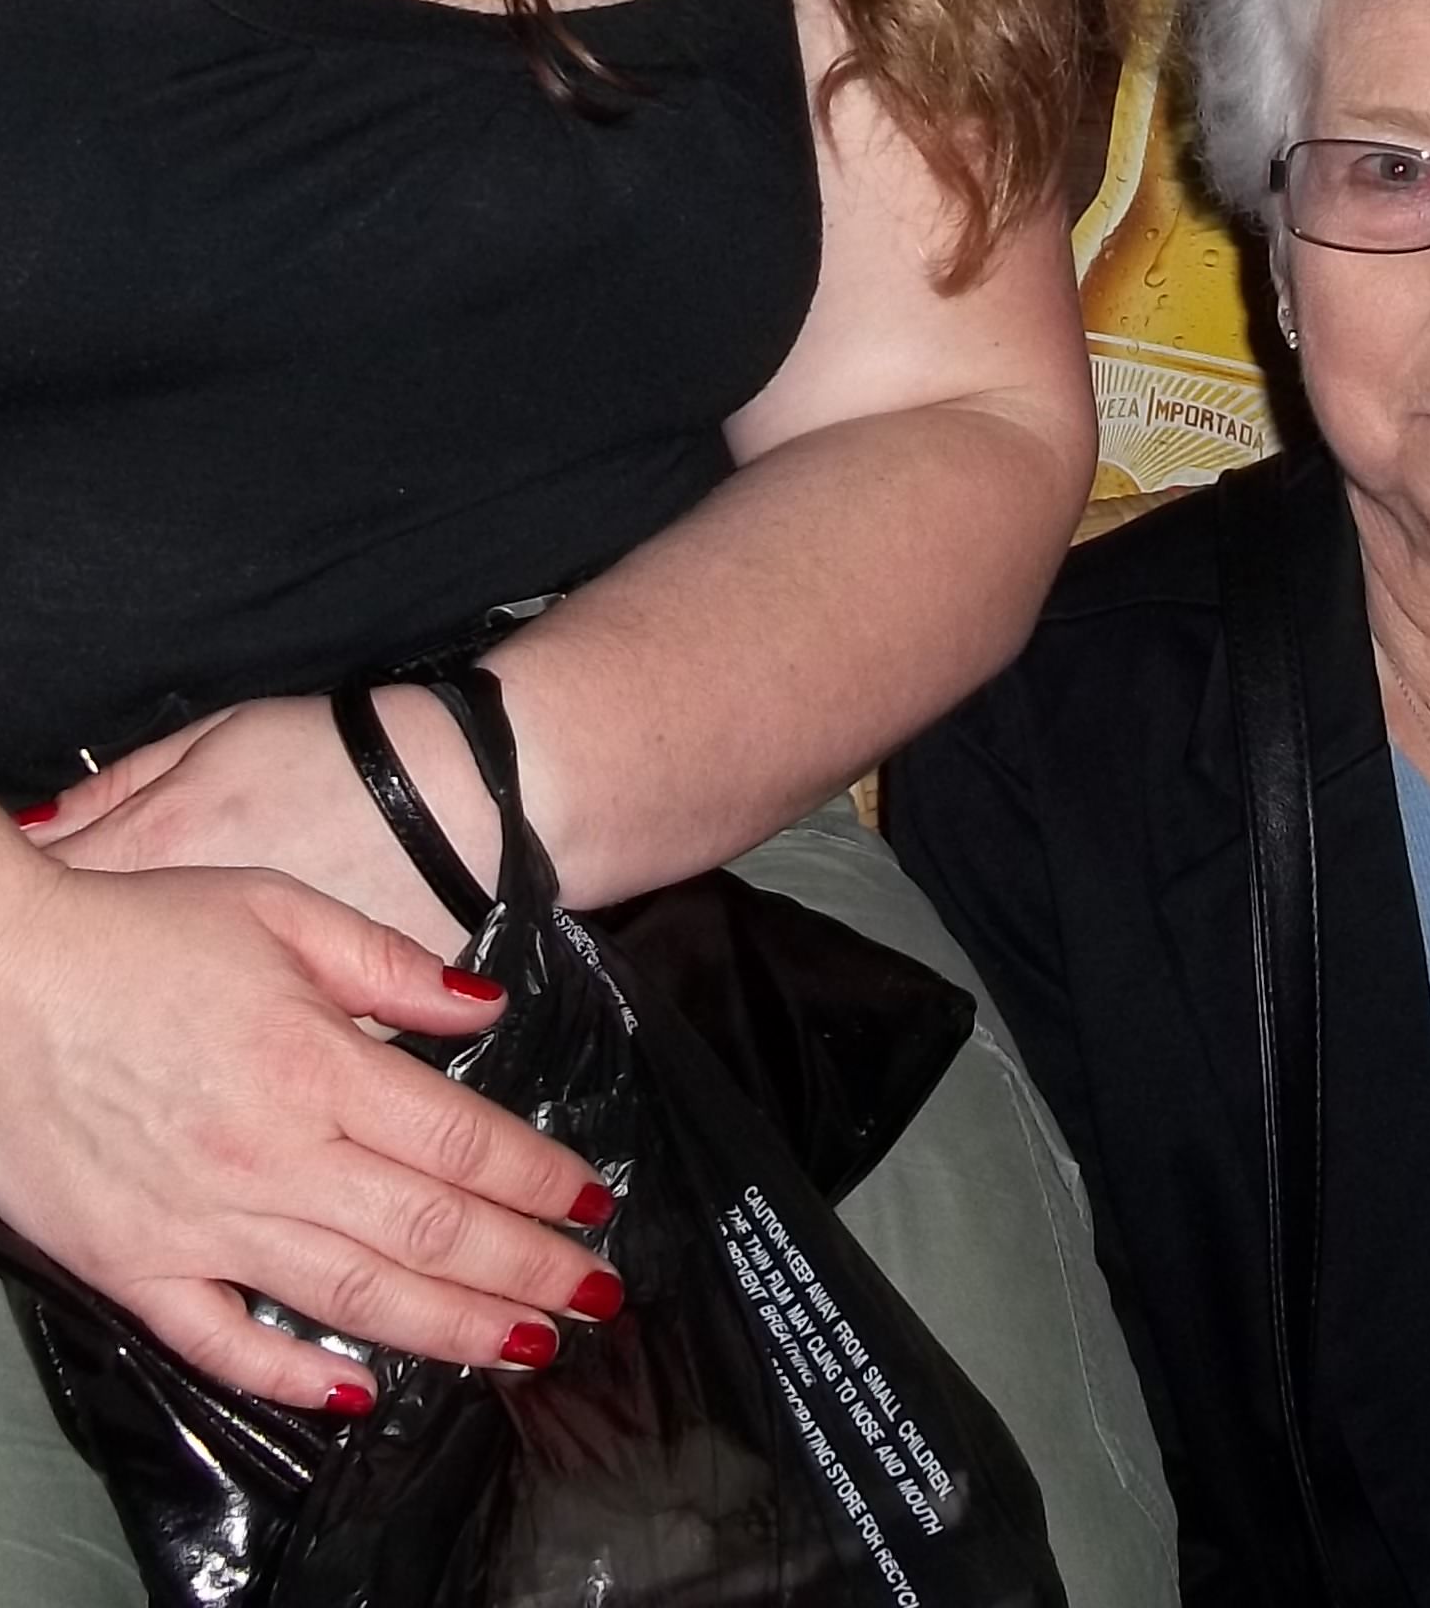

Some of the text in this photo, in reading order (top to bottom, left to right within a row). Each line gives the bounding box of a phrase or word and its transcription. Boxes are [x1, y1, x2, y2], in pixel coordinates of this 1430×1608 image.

[725, 1204, 945, 1537] THE THIN FILM MAY CLING TO NOSE AND MOUTH
[770, 1356, 837, 1473] TICIPATING
[826, 1462, 868, 1521] STORE
[856, 1512, 885, 1552] FOR
[806, 1281, 842, 1324] AWAY
[832, 1319, 870, 1370] FROM
[862, 1365, 903, 1423] SMALL
[897, 1419, 955, 1502] CHILDREN.
